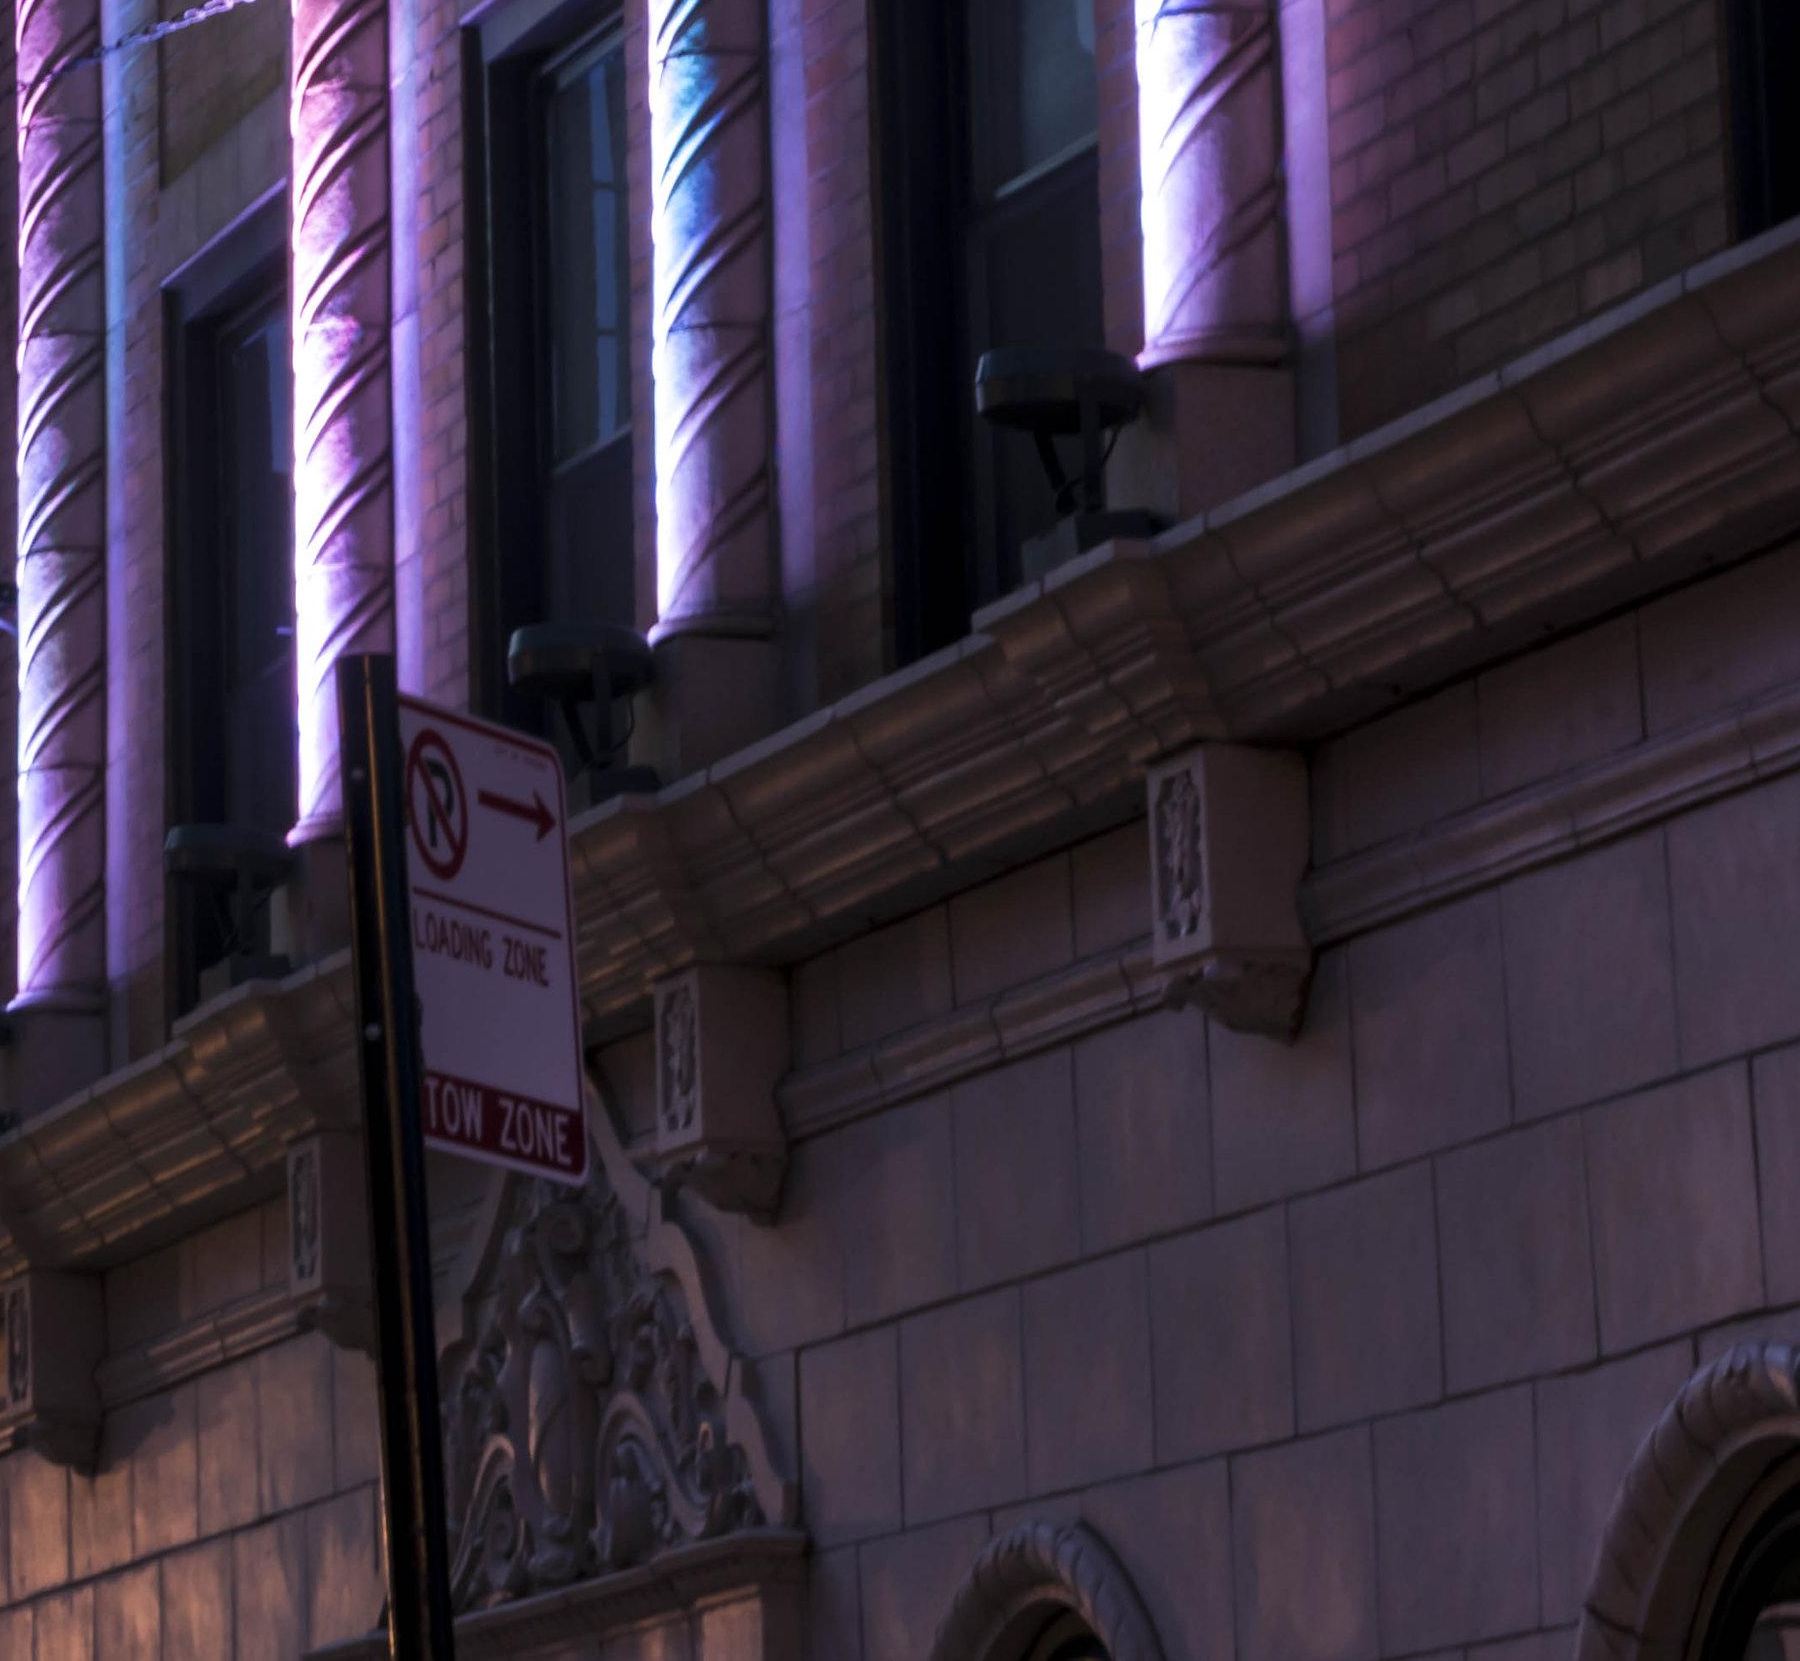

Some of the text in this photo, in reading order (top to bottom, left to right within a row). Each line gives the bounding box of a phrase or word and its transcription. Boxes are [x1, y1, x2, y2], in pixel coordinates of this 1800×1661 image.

[412, 907, 549, 987] LOADING ZONE
[424, 1075, 573, 1166] TOW ZONE
